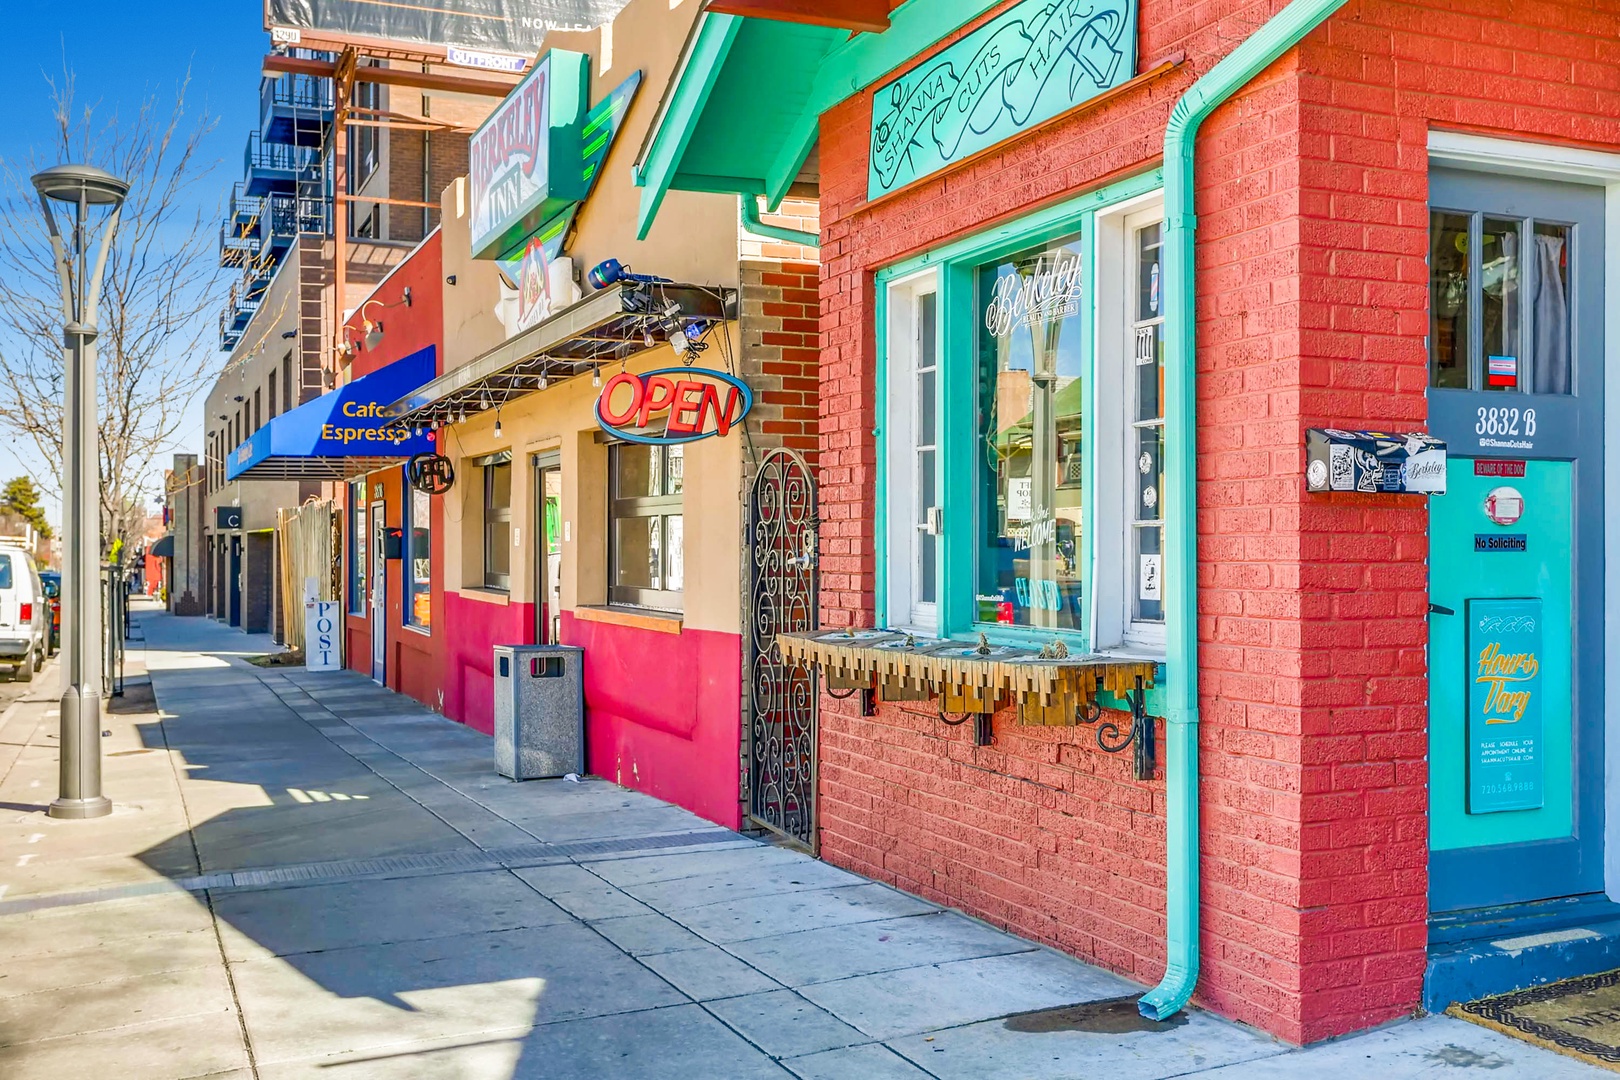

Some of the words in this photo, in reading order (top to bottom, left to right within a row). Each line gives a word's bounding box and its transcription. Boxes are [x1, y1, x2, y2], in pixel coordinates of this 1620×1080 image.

[452, 50, 520, 70] OUTFRONT
[1029, 0, 1094, 80] HAIR
[957, 45, 1001, 113] CUTS
[884, 75, 945, 171] SHANNA
[471, 71, 546, 231] BERKELEY
[489, 170, 520, 230] INN
[985, 249, 1082, 336] Berkeley
[1022, 312, 1043, 323] BEAUTY
[1053, 303, 1076, 317] BARBER
[600, 372, 739, 437] OPEN
[1475, 406, 1520, 436] 3832
[1523, 408, 1537, 437] B
[321, 423, 407, 445] Espresso
[1476, 463, 1497, 474] BEWARE
[1497, 463, 1504, 475] OF
[1504, 463, 1513, 475] THE
[1513, 464, 1524, 475] DOG
[1014, 518, 1057, 552] WELCOME
[1475, 537, 1487, 550] No
[1488, 537, 1526, 552] Soliciting
[1015, 577, 1063, 612] CLOSED
[316, 602, 332, 666] POST
[1477, 642, 1539, 684] Hours
[1483, 680, 1531, 725] Vary
